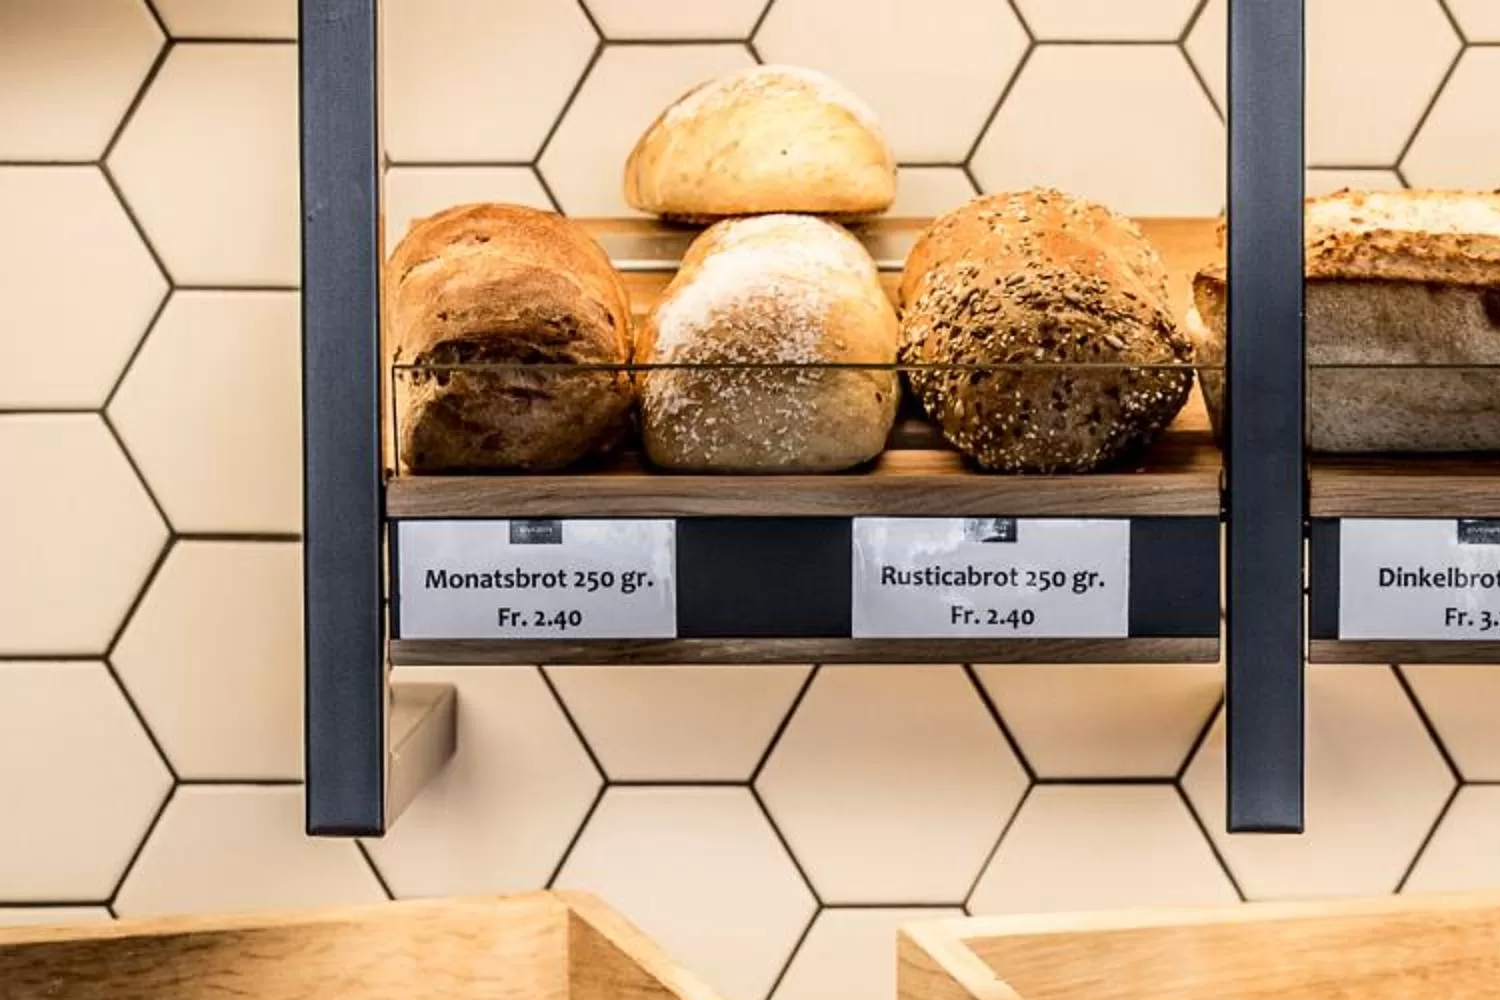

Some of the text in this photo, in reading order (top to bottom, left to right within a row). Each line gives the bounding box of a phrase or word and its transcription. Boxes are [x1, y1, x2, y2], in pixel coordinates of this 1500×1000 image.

[425, 568, 653, 594] Monatsbrot 250 gr.
[881, 565, 1105, 594] Rusticabrot 250 gr.
[498, 608, 582, 630] Fr. 2.40
[951, 606, 1035, 629] Fr. 2.40
[1445, 608, 1473, 627] Fr.
